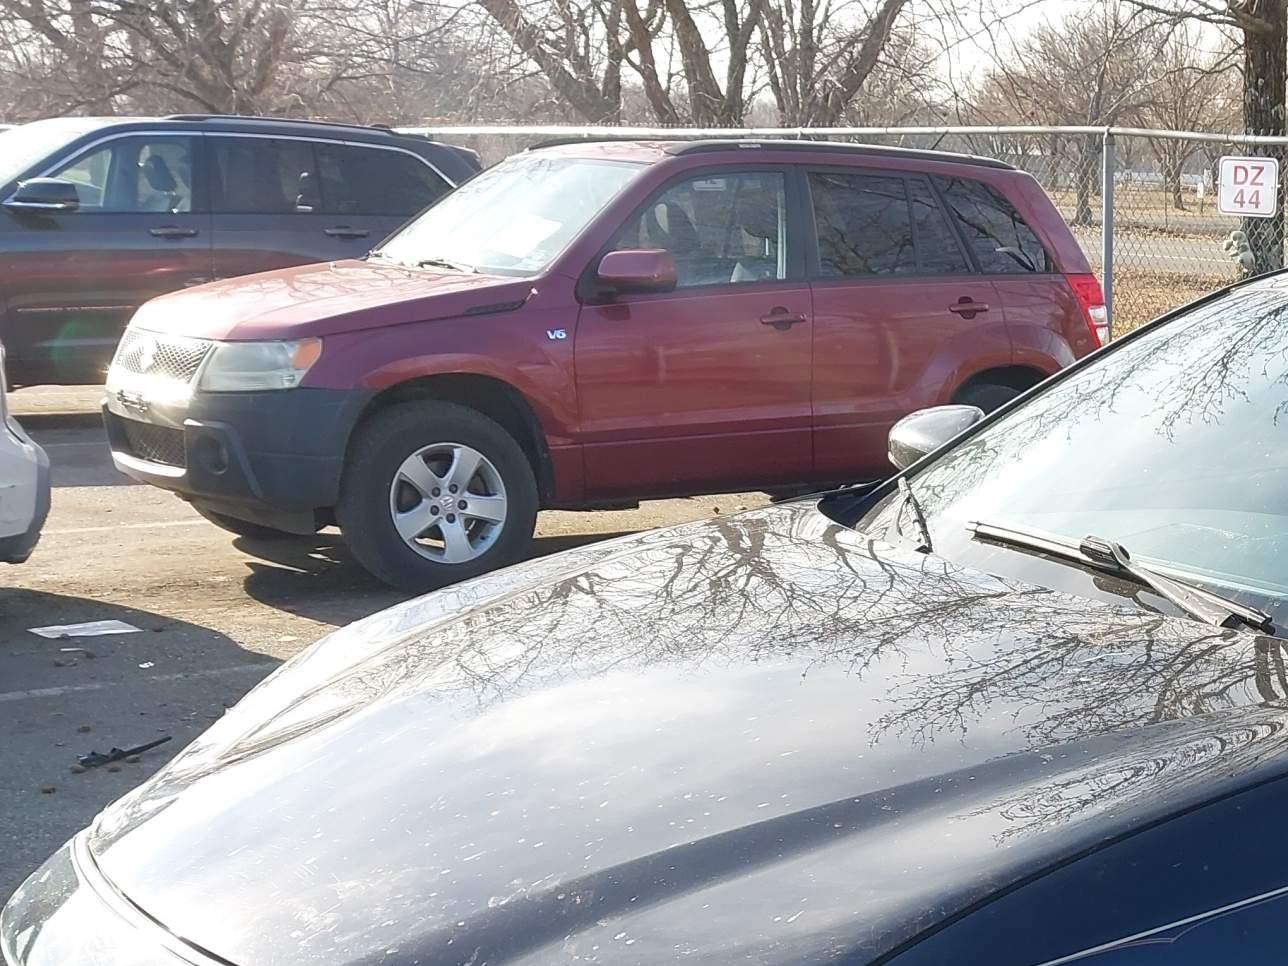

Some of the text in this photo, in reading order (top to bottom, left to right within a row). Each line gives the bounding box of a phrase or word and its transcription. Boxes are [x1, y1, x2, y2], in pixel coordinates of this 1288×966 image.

[1233, 165, 1264, 186] DZ
[1233, 189, 1261, 209] 44
[546, 329, 567, 339] V6
